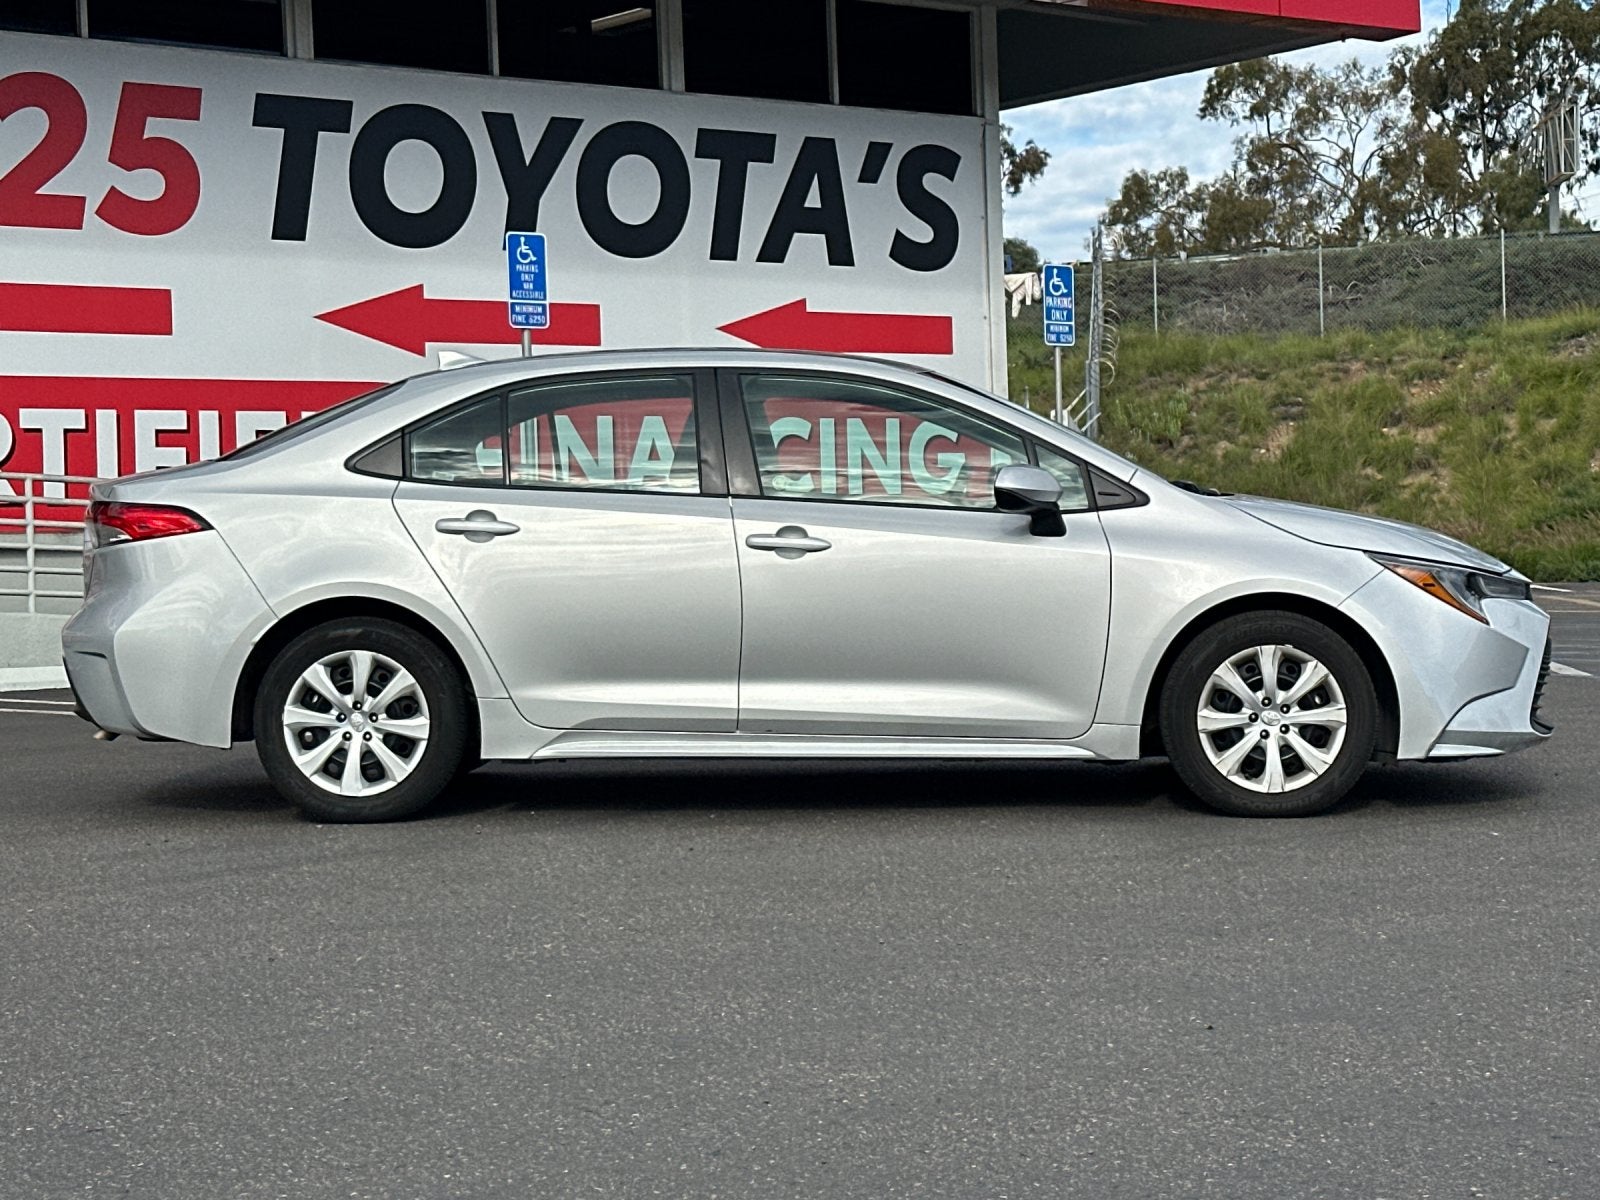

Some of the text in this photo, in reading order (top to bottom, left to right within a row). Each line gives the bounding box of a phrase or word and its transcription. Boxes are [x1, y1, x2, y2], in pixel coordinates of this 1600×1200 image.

[0, 72, 962, 272] 25 TOYOTA'S
[516, 264, 539, 273] PARKING
[512, 290, 544, 299] ACCESSIBLE
[1046, 296, 1072, 308] PARKING
[515, 305, 542, 313] MINIMUM
[512, 314, 526, 323] FINE
[1051, 309, 1067, 320] ONLY
